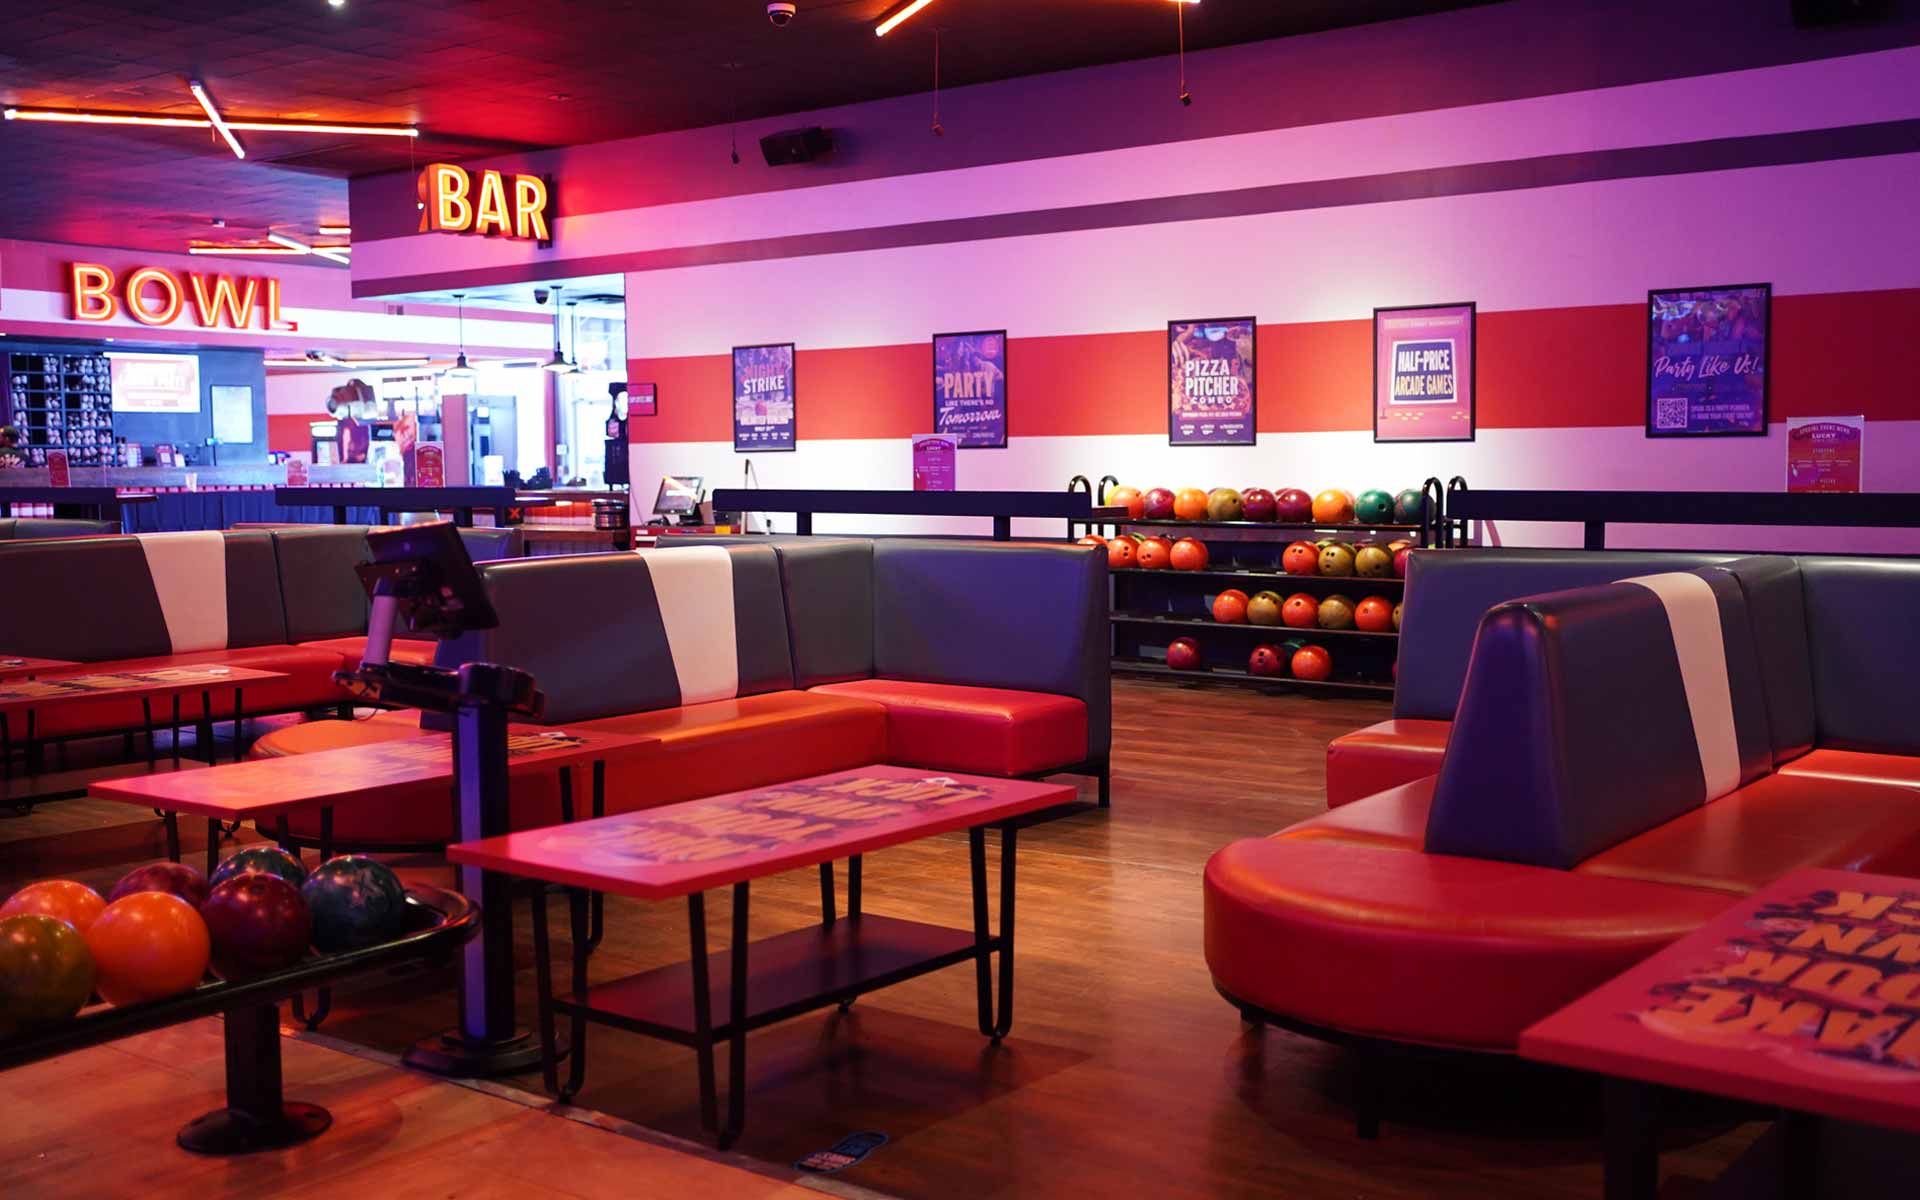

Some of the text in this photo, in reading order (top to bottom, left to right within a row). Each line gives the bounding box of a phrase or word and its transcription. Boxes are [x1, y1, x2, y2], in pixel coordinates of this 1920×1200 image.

[428, 163, 550, 241] BAR
[72, 261, 298, 332] BOWL
[1185, 359, 1230, 377] PIZZA
[1397, 349, 1451, 373] HALF-PRICE
[1654, 353, 1759, 381] Party Like Us!
[743, 374, 785, 395] STRIKE
[943, 370, 995, 399] PARTY
[1185, 376, 1239, 396] PITCHER
[1394, 373, 1454, 396] ARCADE GAMES
[1190, 396, 1233, 404] COMBO
[938, 406, 1002, 426] Tomorrow
